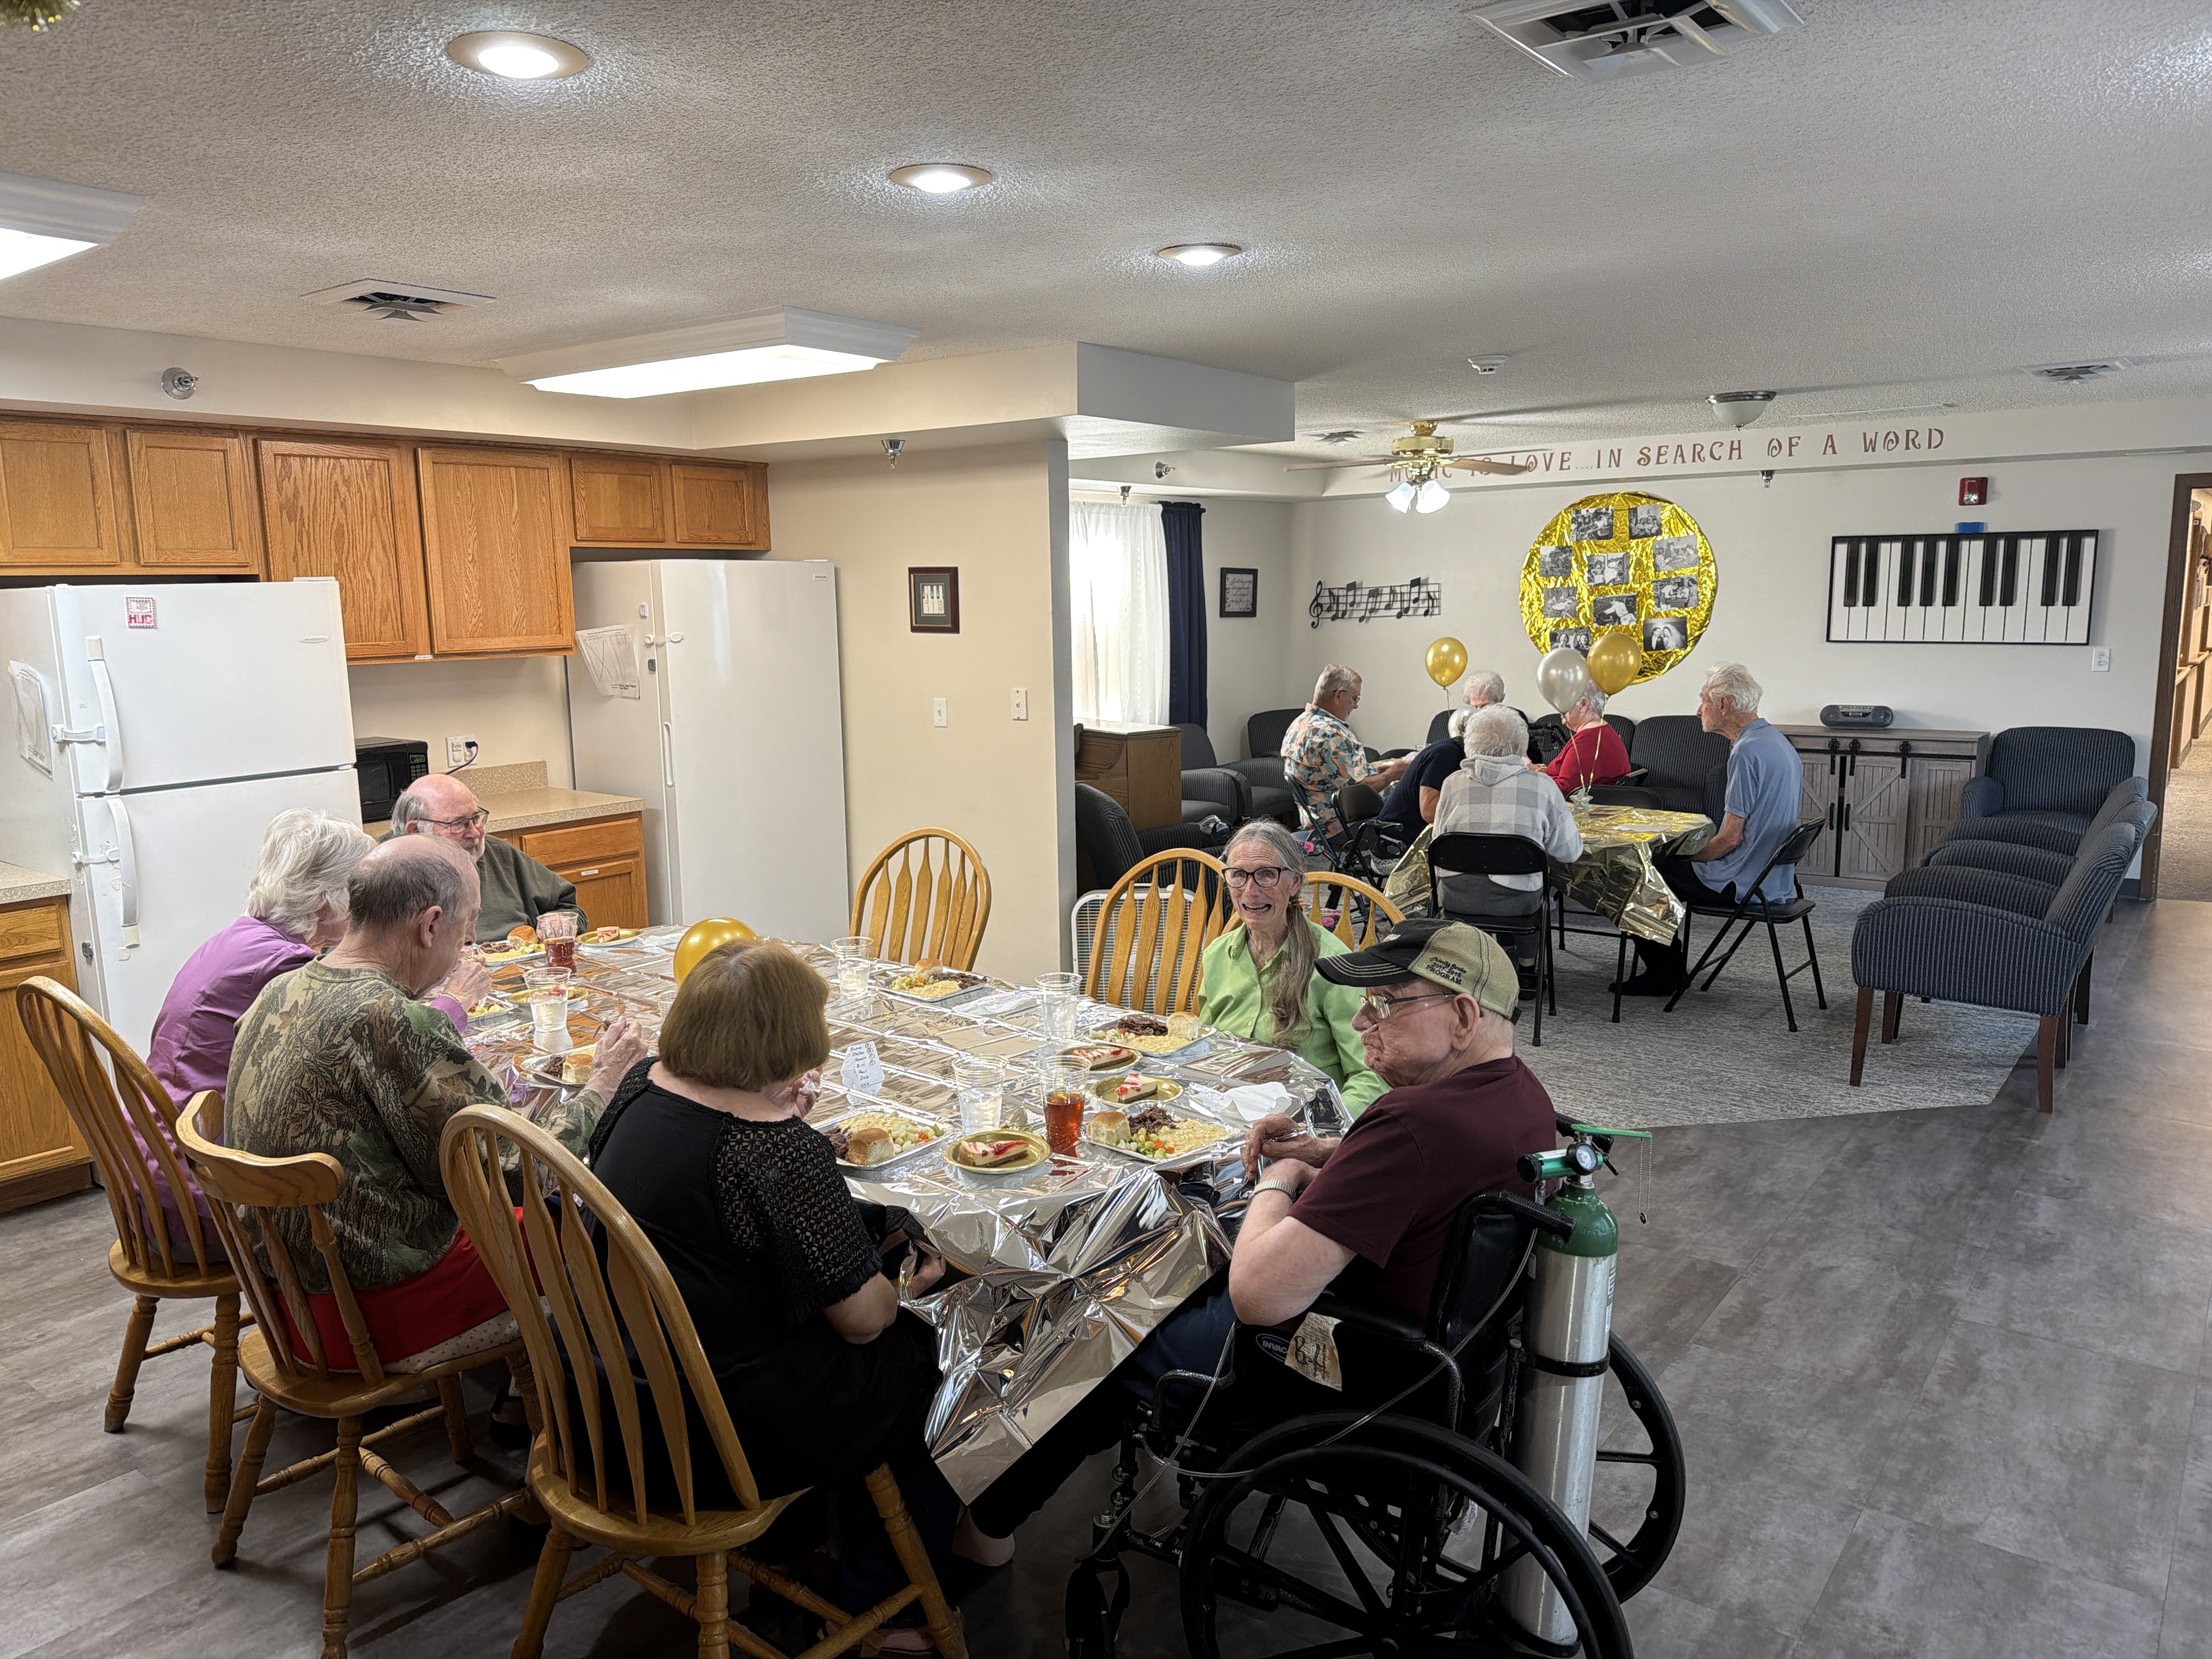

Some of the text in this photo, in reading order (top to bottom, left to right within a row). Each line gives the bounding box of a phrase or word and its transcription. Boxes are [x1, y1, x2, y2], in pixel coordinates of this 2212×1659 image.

[1637, 439, 1742, 466] SEARCH
[1767, 436, 1801, 458] OF
[1822, 435, 1838, 455] A
[1863, 428, 1944, 453] WORD
[1426, 964, 1462, 985] PROGRAM
[1262, 1340, 1289, 1354] INVAC
